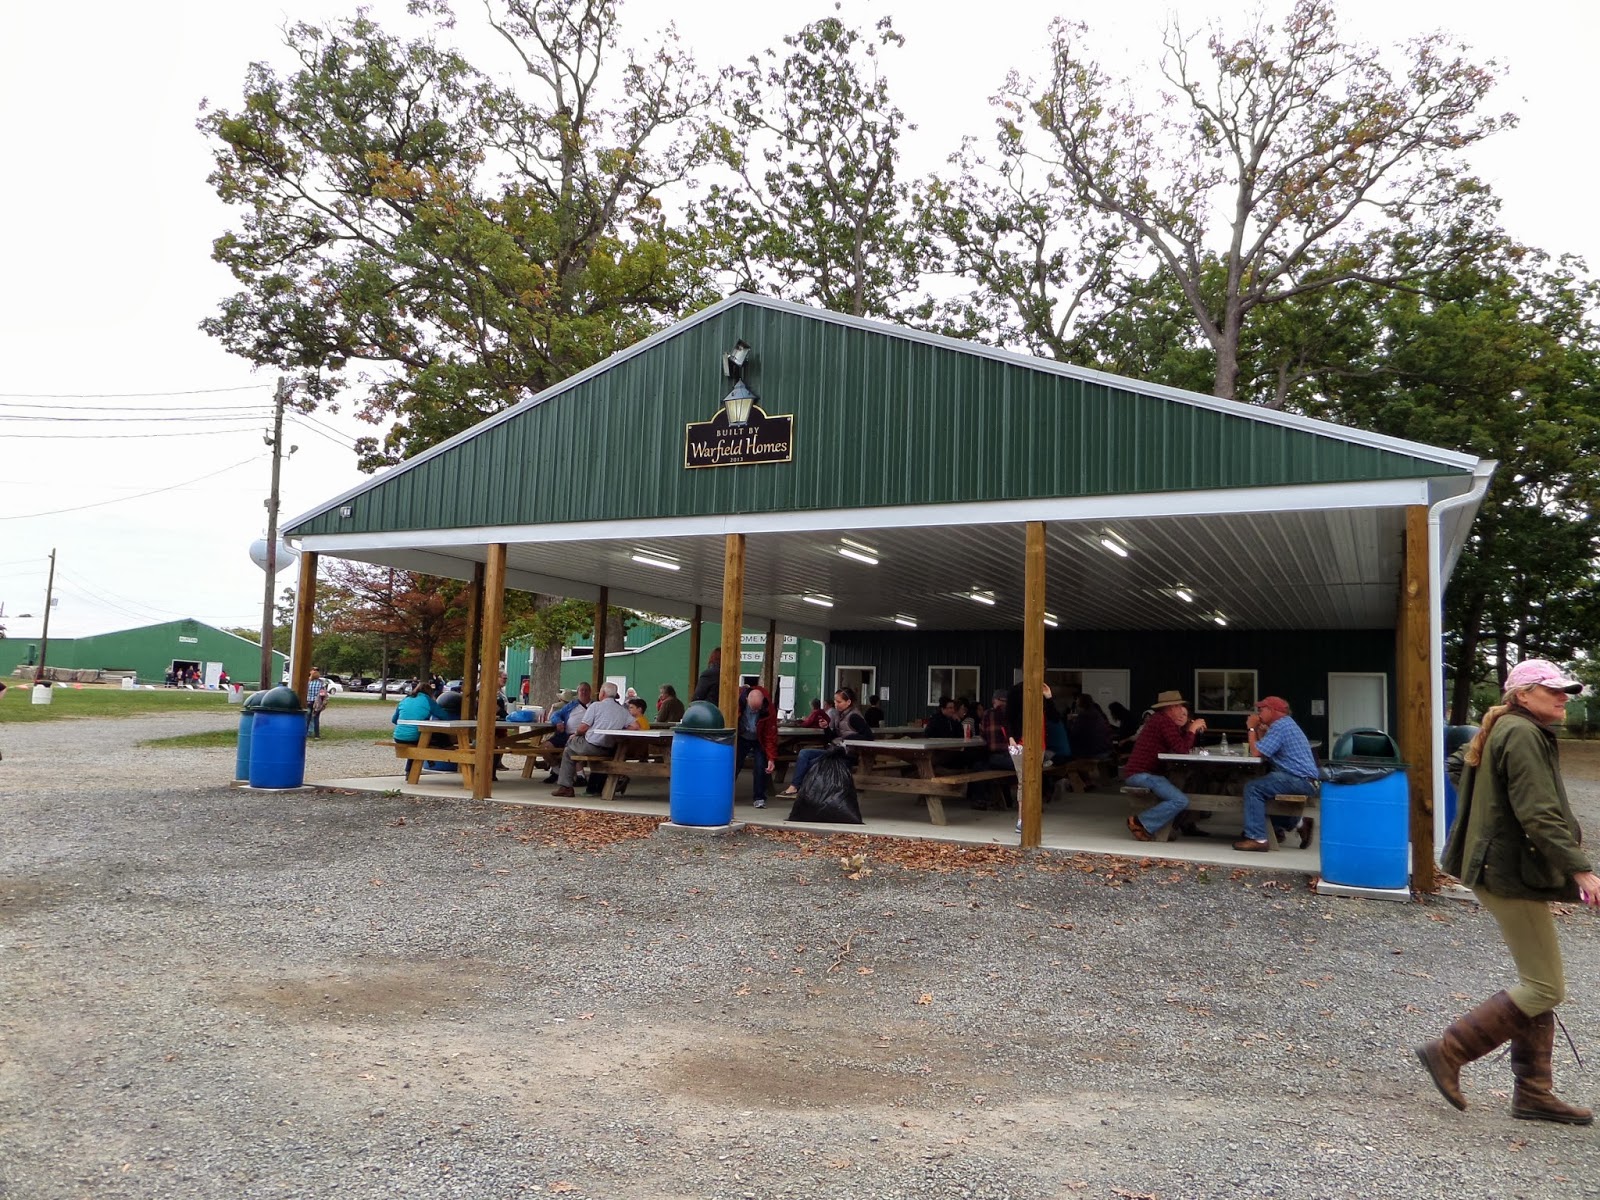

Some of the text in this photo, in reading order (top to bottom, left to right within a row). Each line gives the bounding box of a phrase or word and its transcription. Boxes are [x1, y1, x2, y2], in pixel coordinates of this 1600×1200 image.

[716, 426, 760, 437] BUILT BY
[690, 434, 788, 463] Warfield Homes
[740, 635, 757, 643] OME
